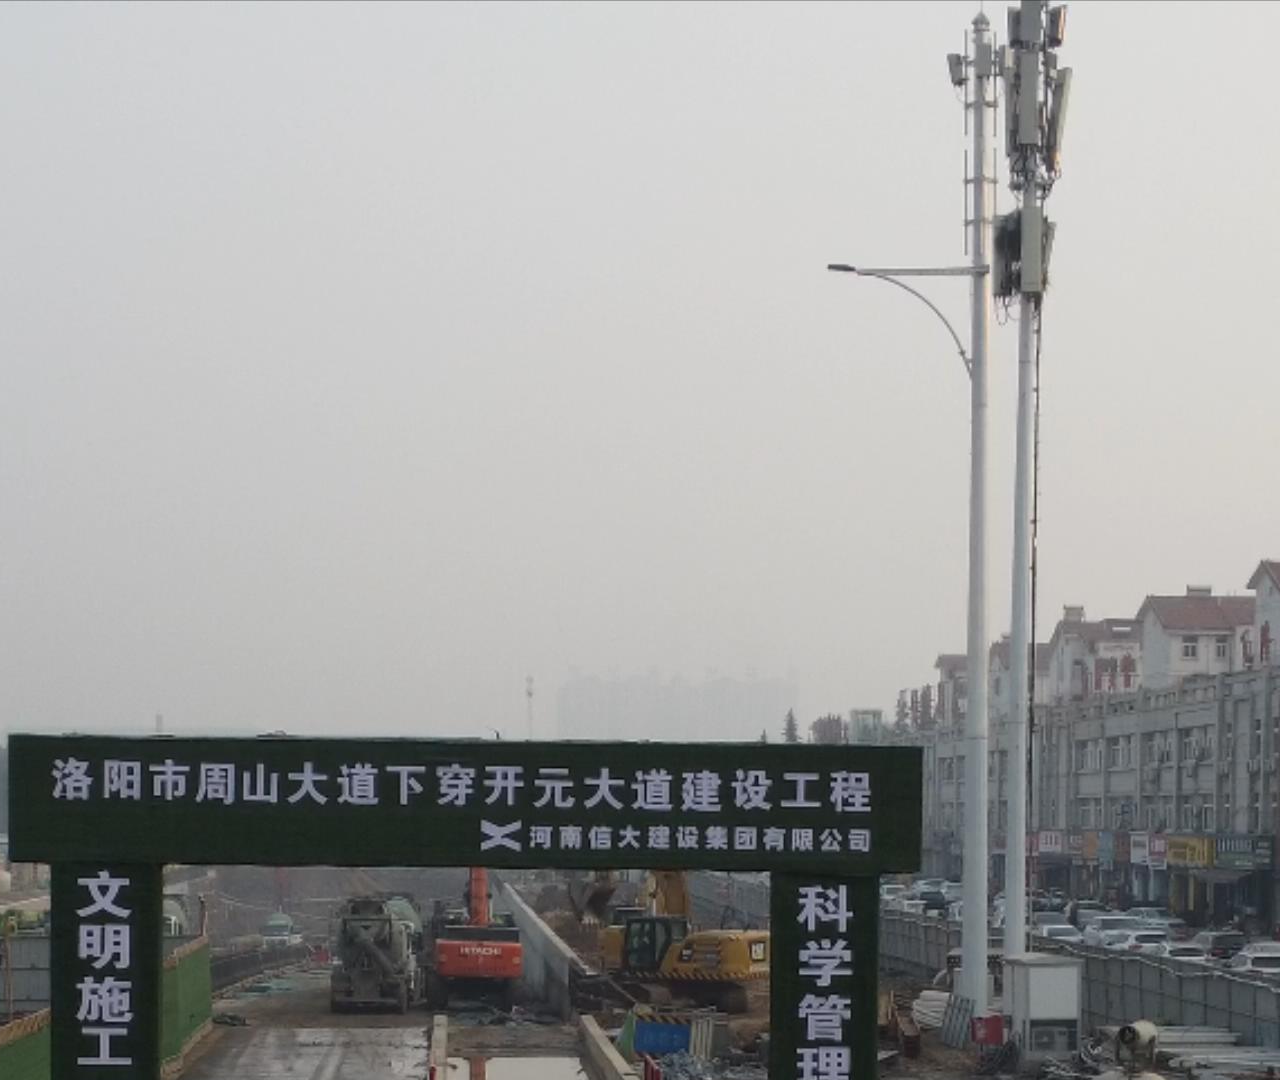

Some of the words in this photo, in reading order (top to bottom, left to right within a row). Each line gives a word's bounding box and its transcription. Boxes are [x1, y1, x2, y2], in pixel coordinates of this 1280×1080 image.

[52, 757, 873, 814] 洛阳市周山大道下穿开元大道建设工程
[529, 825, 872, 854] 河南信大建设集团有限公司
[76, 871, 133, 1064] 文明施工
